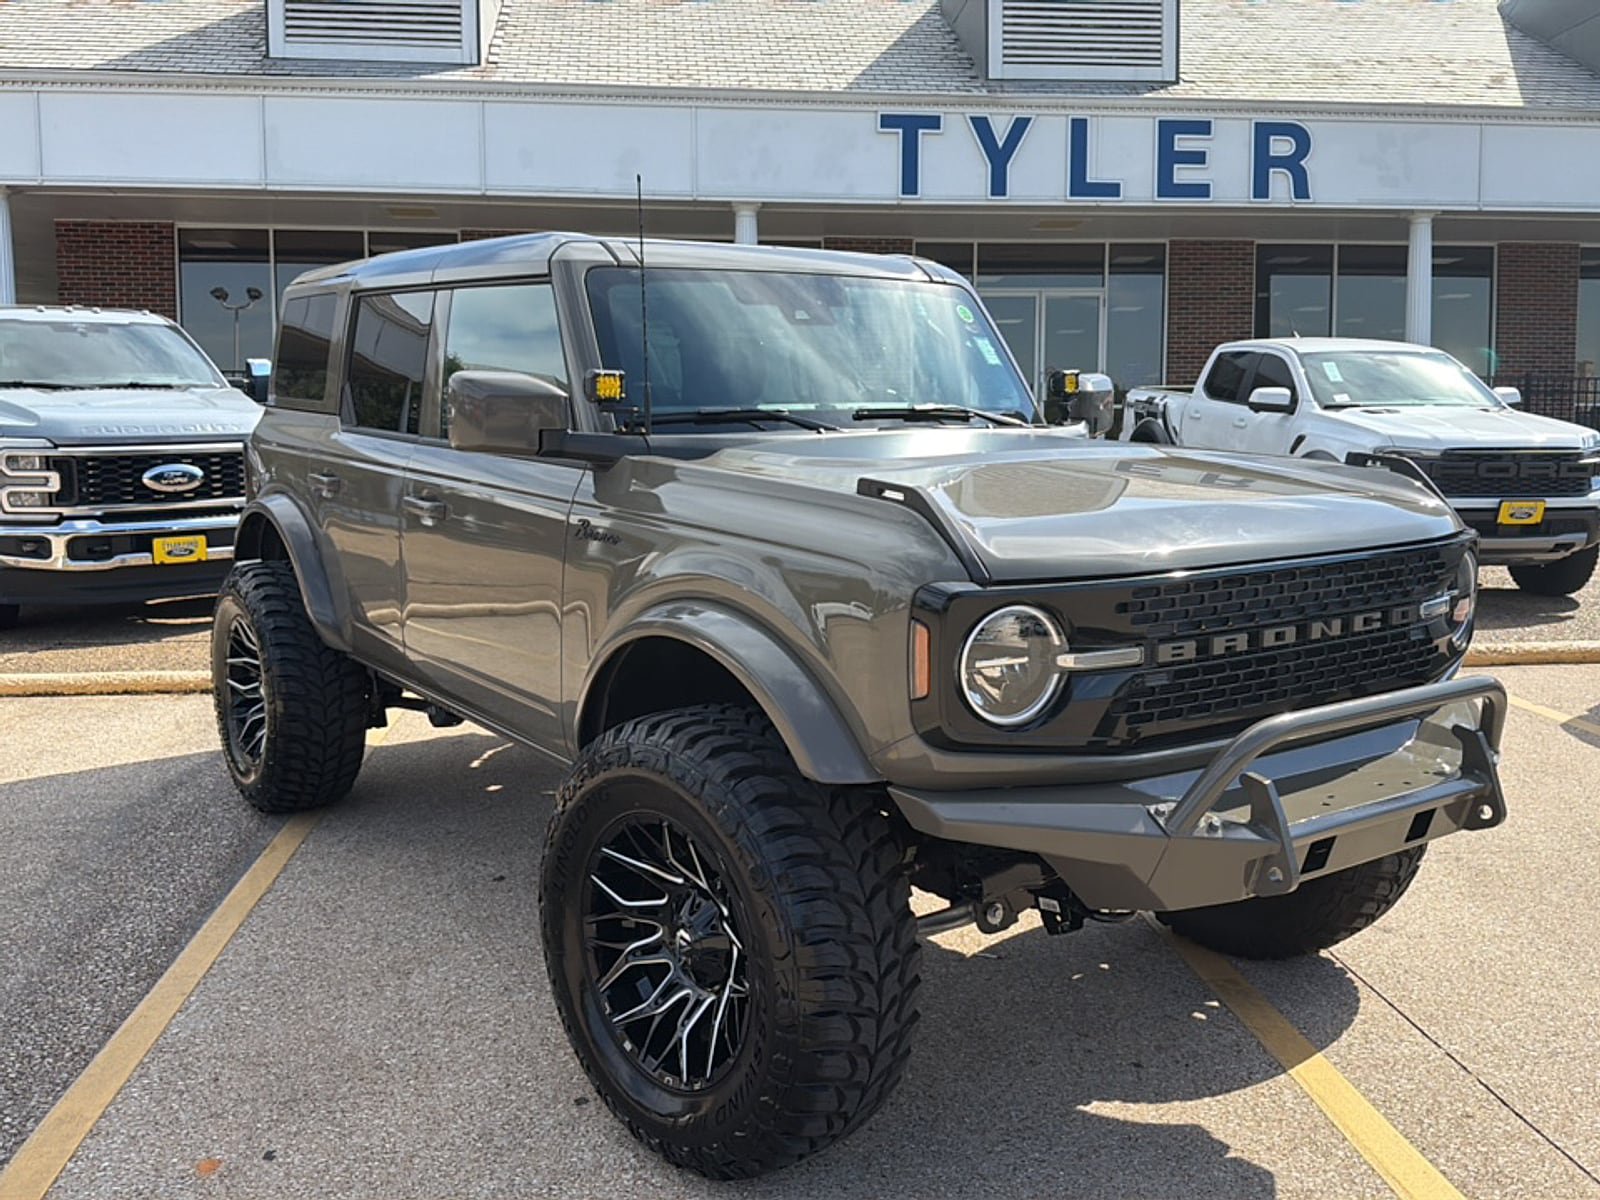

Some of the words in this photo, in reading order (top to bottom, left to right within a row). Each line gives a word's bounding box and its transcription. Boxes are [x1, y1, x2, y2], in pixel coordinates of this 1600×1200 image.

[878, 111, 1312, 200] TYLER
[1431, 461, 1593, 478] FORD
[1158, 605, 1418, 663] BRONCO
